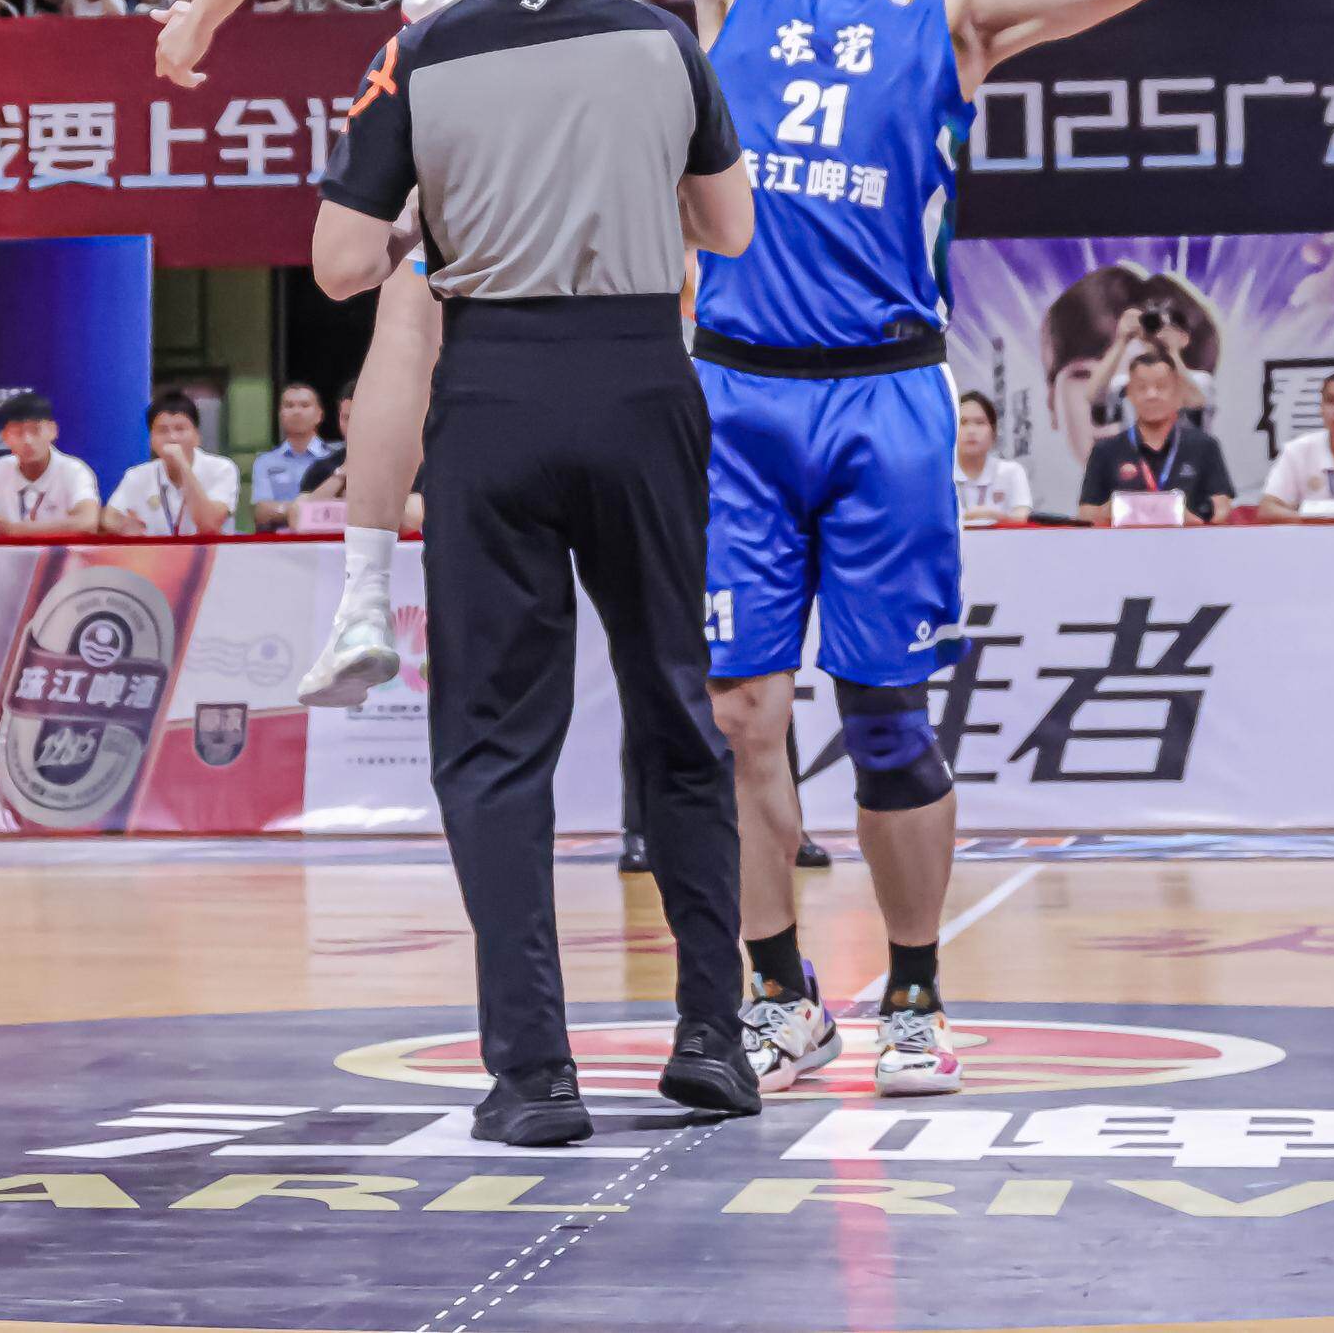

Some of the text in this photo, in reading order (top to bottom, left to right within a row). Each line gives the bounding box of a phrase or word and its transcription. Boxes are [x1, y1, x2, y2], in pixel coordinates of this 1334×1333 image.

[769, 19, 875, 75] 东莞
[776, 79, 851, 147] 21
[15, 664, 162, 709] 珠江啤酒
